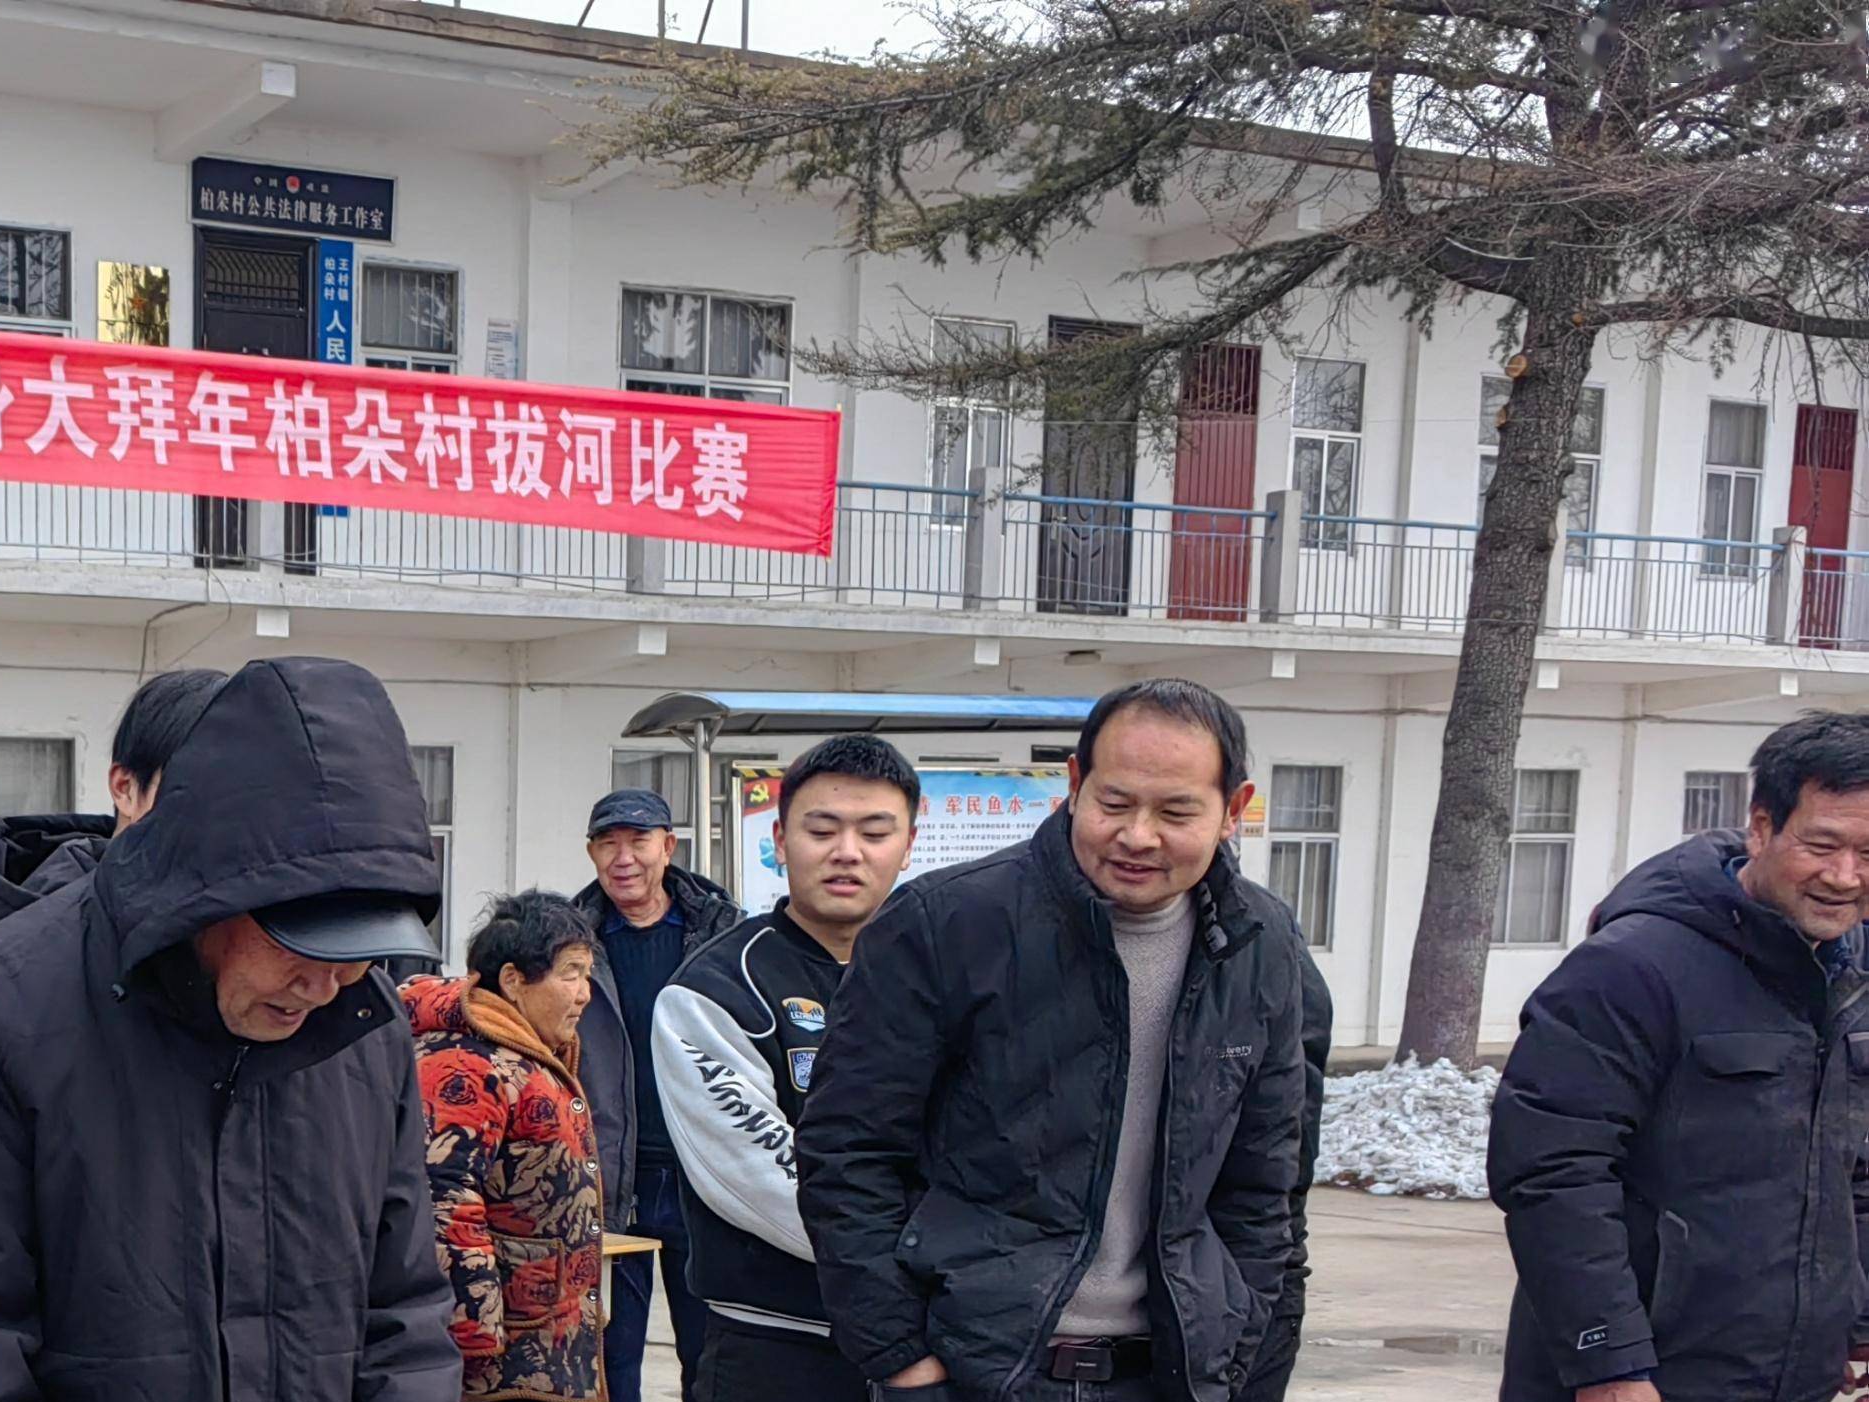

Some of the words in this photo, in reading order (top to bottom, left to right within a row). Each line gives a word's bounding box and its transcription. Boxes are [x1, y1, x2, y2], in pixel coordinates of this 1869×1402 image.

[200, 187, 384, 230] 柏朵村公共法律服务工作室
[337, 258, 350, 302] 王村镇
[325, 309, 347, 362] 人民
